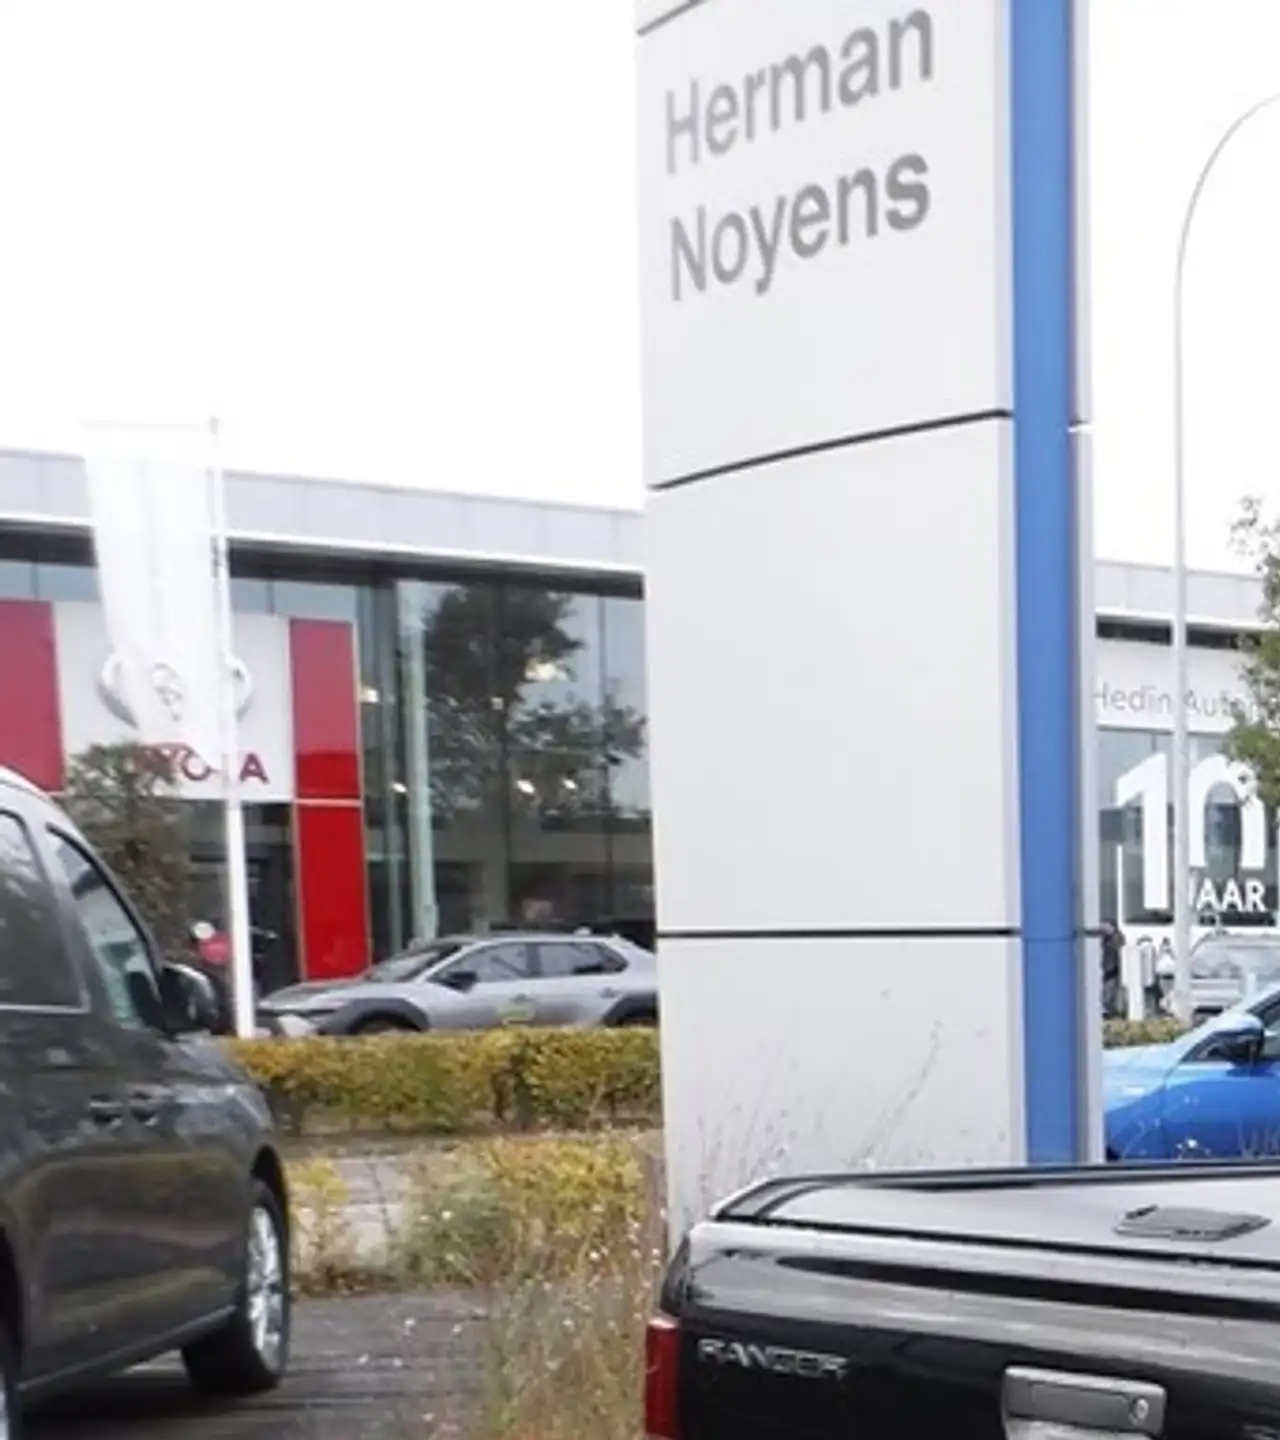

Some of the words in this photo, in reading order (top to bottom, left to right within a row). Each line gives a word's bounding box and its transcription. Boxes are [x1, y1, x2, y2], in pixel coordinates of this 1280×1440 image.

[666, 8, 932, 175] Herman
[671, 153, 931, 301] Noyens
[1116, 751, 1267, 911] 10
[698, 1337, 849, 1380] RANGER
